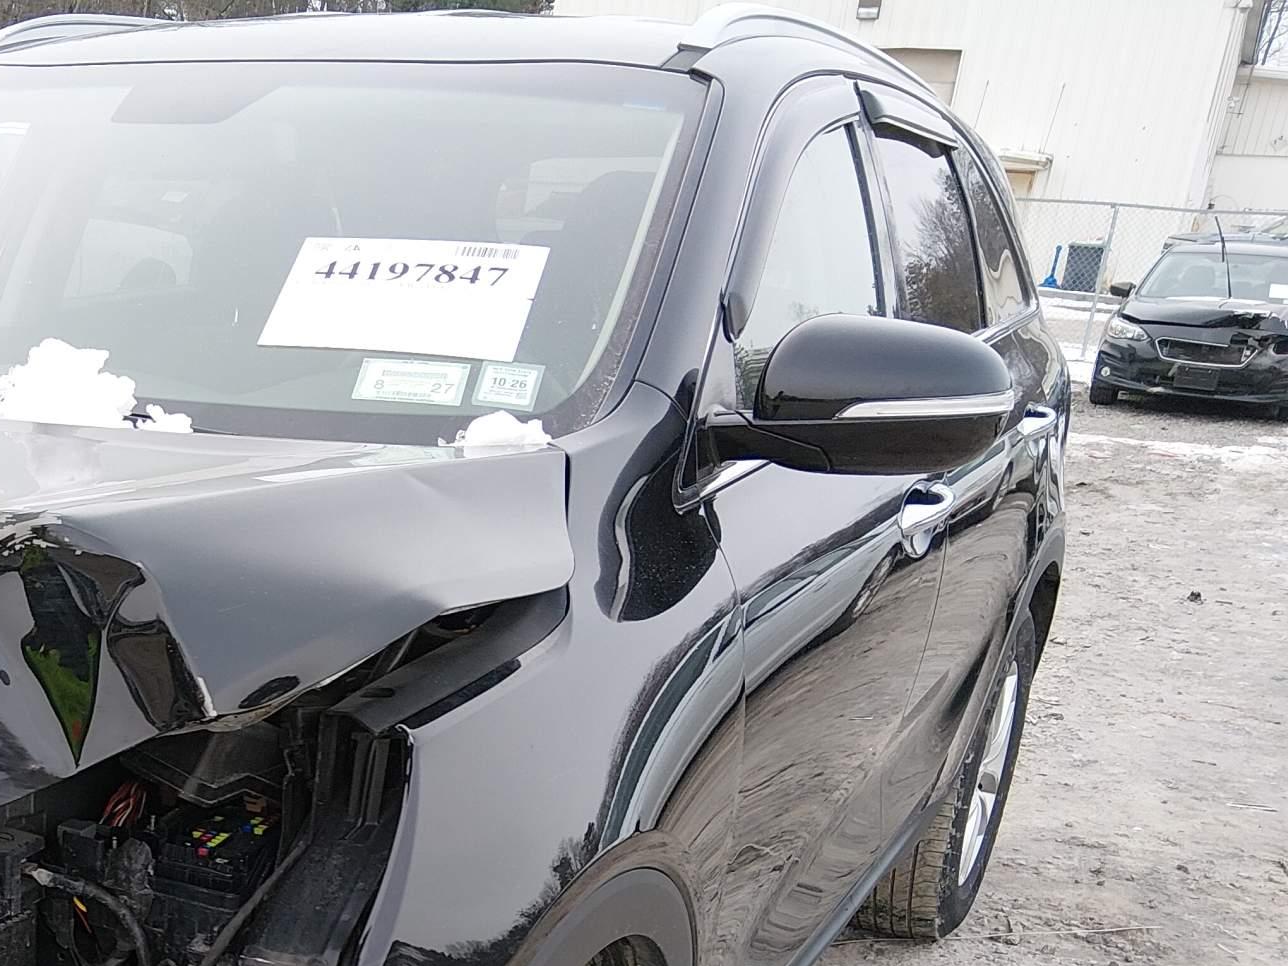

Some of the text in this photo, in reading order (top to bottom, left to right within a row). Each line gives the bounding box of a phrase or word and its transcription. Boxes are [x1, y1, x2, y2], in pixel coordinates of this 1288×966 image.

[314, 260, 510, 287] 44197847
[373, 379, 455, 394] 8 27
[492, 377, 528, 389] 10 26
